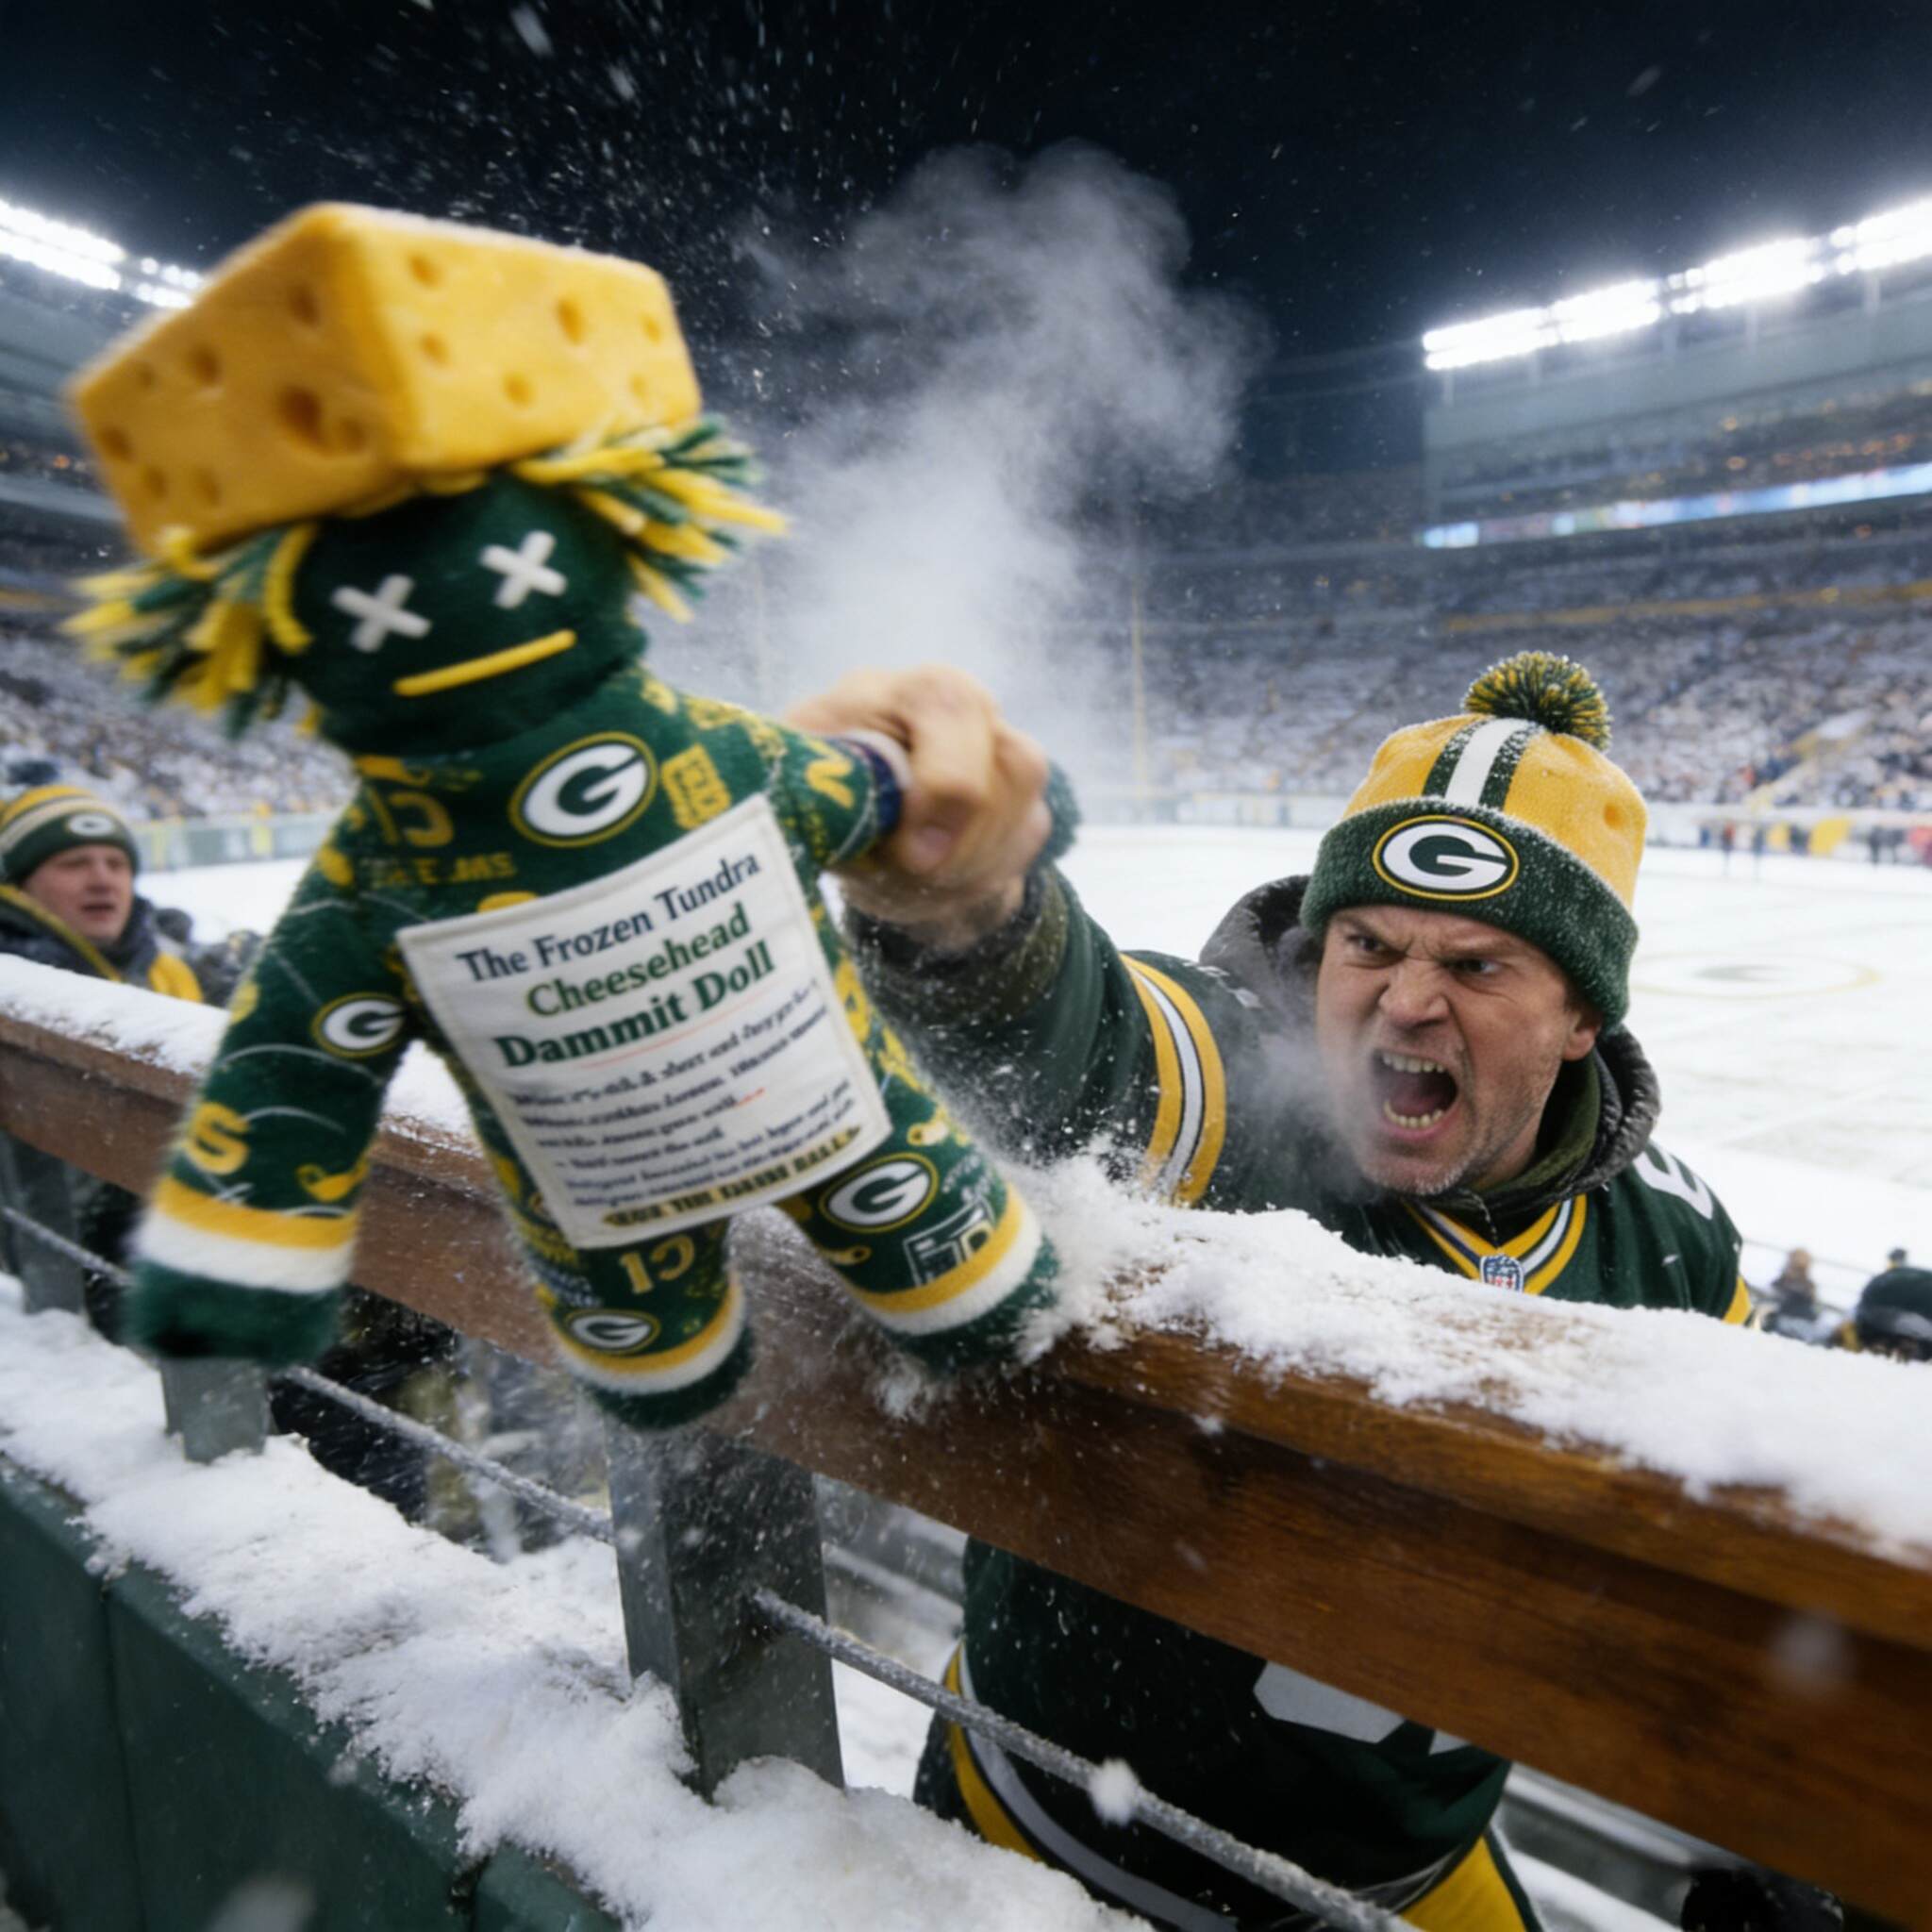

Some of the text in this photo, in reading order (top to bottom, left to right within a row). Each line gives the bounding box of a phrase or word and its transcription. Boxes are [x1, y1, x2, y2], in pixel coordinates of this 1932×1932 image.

[523, 743, 648, 837] G
[1382, 822, 1507, 891] G
[458, 855, 760, 983] The Frozen Tundra
[526, 903, 752, 1017] Cheesehead
[493, 992, 689, 1068] Dammit
[691, 941, 775, 1012] Doll
[828, 1160, 929, 1226] G
